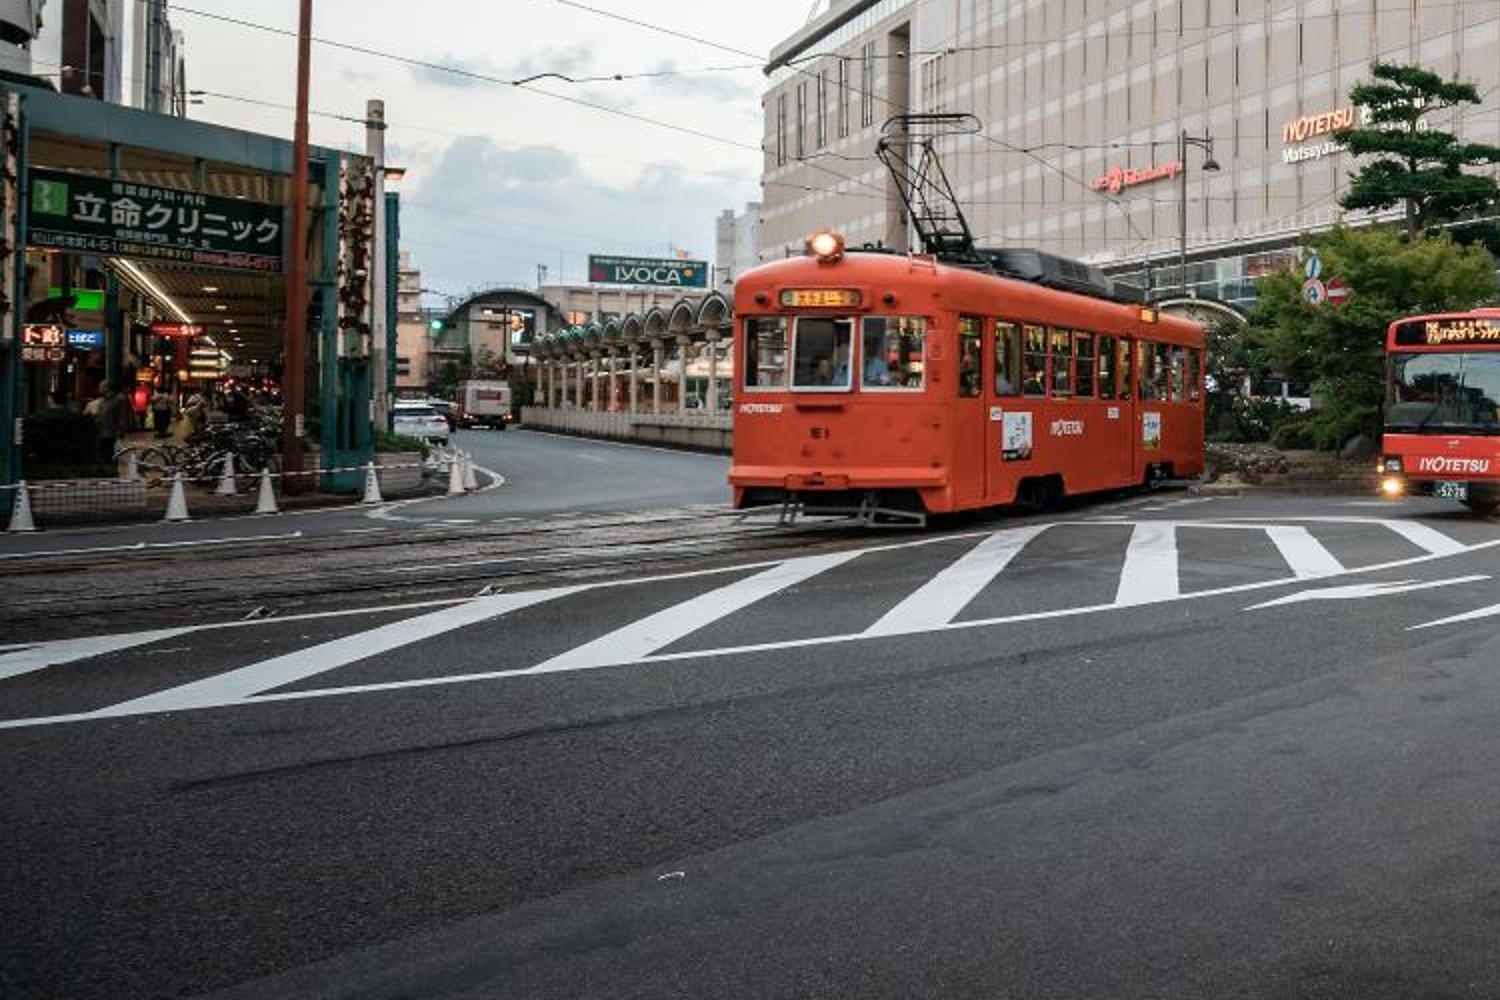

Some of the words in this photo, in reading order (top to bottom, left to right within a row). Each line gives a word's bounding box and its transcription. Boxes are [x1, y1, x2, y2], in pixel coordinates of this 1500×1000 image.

[1281, 105, 1355, 143] IYOTETSU
[72, 192, 281, 244] 立命クリニック
[615, 266, 681, 285] IYOCA
[1419, 456, 1490, 473] IYOTETSU
